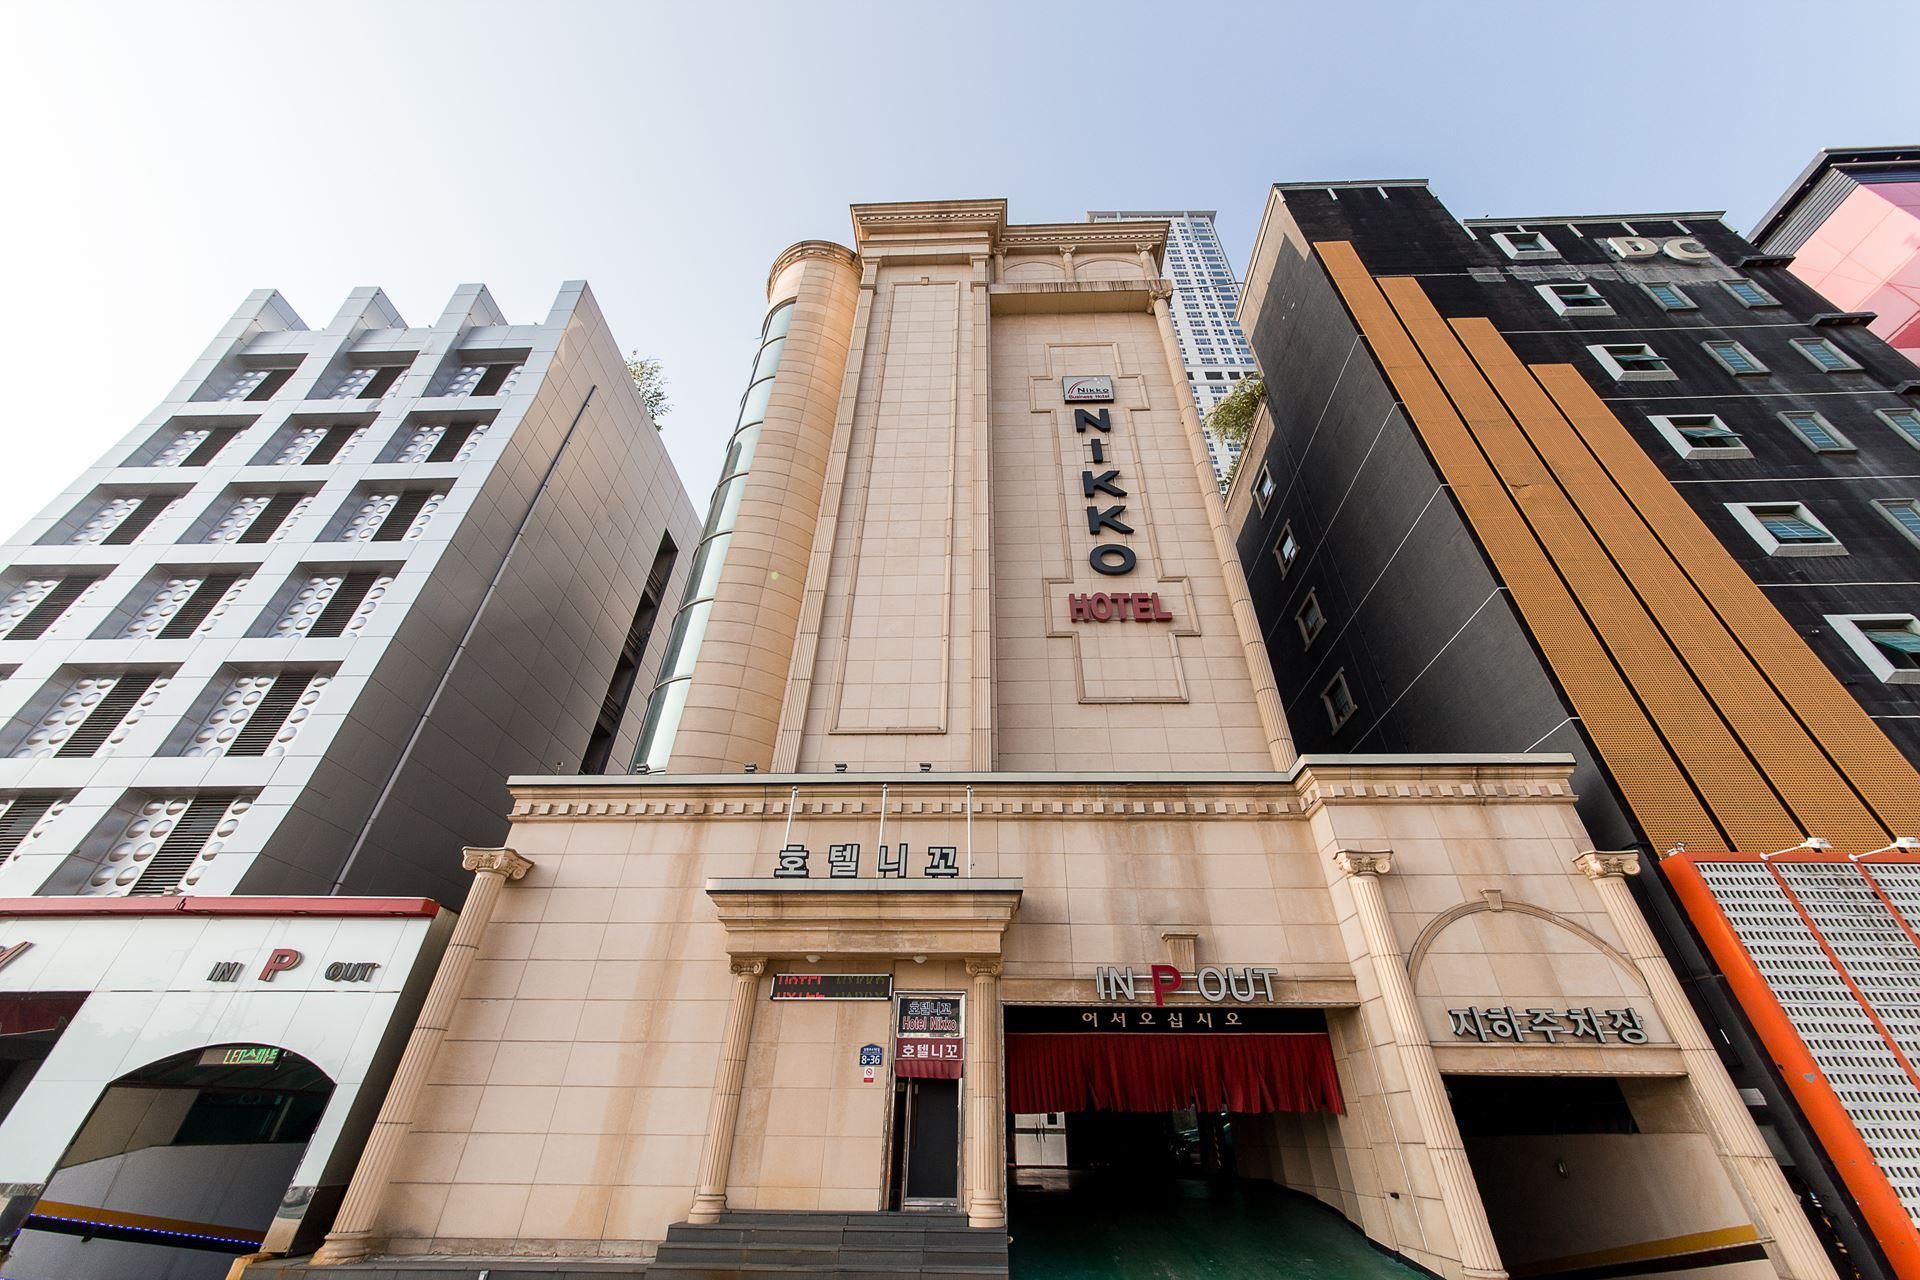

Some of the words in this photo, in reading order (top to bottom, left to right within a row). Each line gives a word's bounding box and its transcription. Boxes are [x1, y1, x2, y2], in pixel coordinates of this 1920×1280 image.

[1607, 236, 1711, 262] DC
[1074, 408, 1136, 576] NIKKO
[1068, 592, 1173, 623] HOTEL
[773, 843, 959, 878] 호텔니꼬
[206, 961, 245, 983] IN
[257, 948, 304, 982] P
[324, 961, 381, 983] OUT
[1096, 966, 1136, 1001] IN
[1151, 964, 1182, 1007] P
[1197, 967, 1278, 1002] OUT
[902, 1015, 927, 1031] Hotel
[930, 1016, 957, 1031] Nikko
[1447, 1006, 1649, 1045] 지하주차장
[861, 1054, 880, 1065] 8-36
